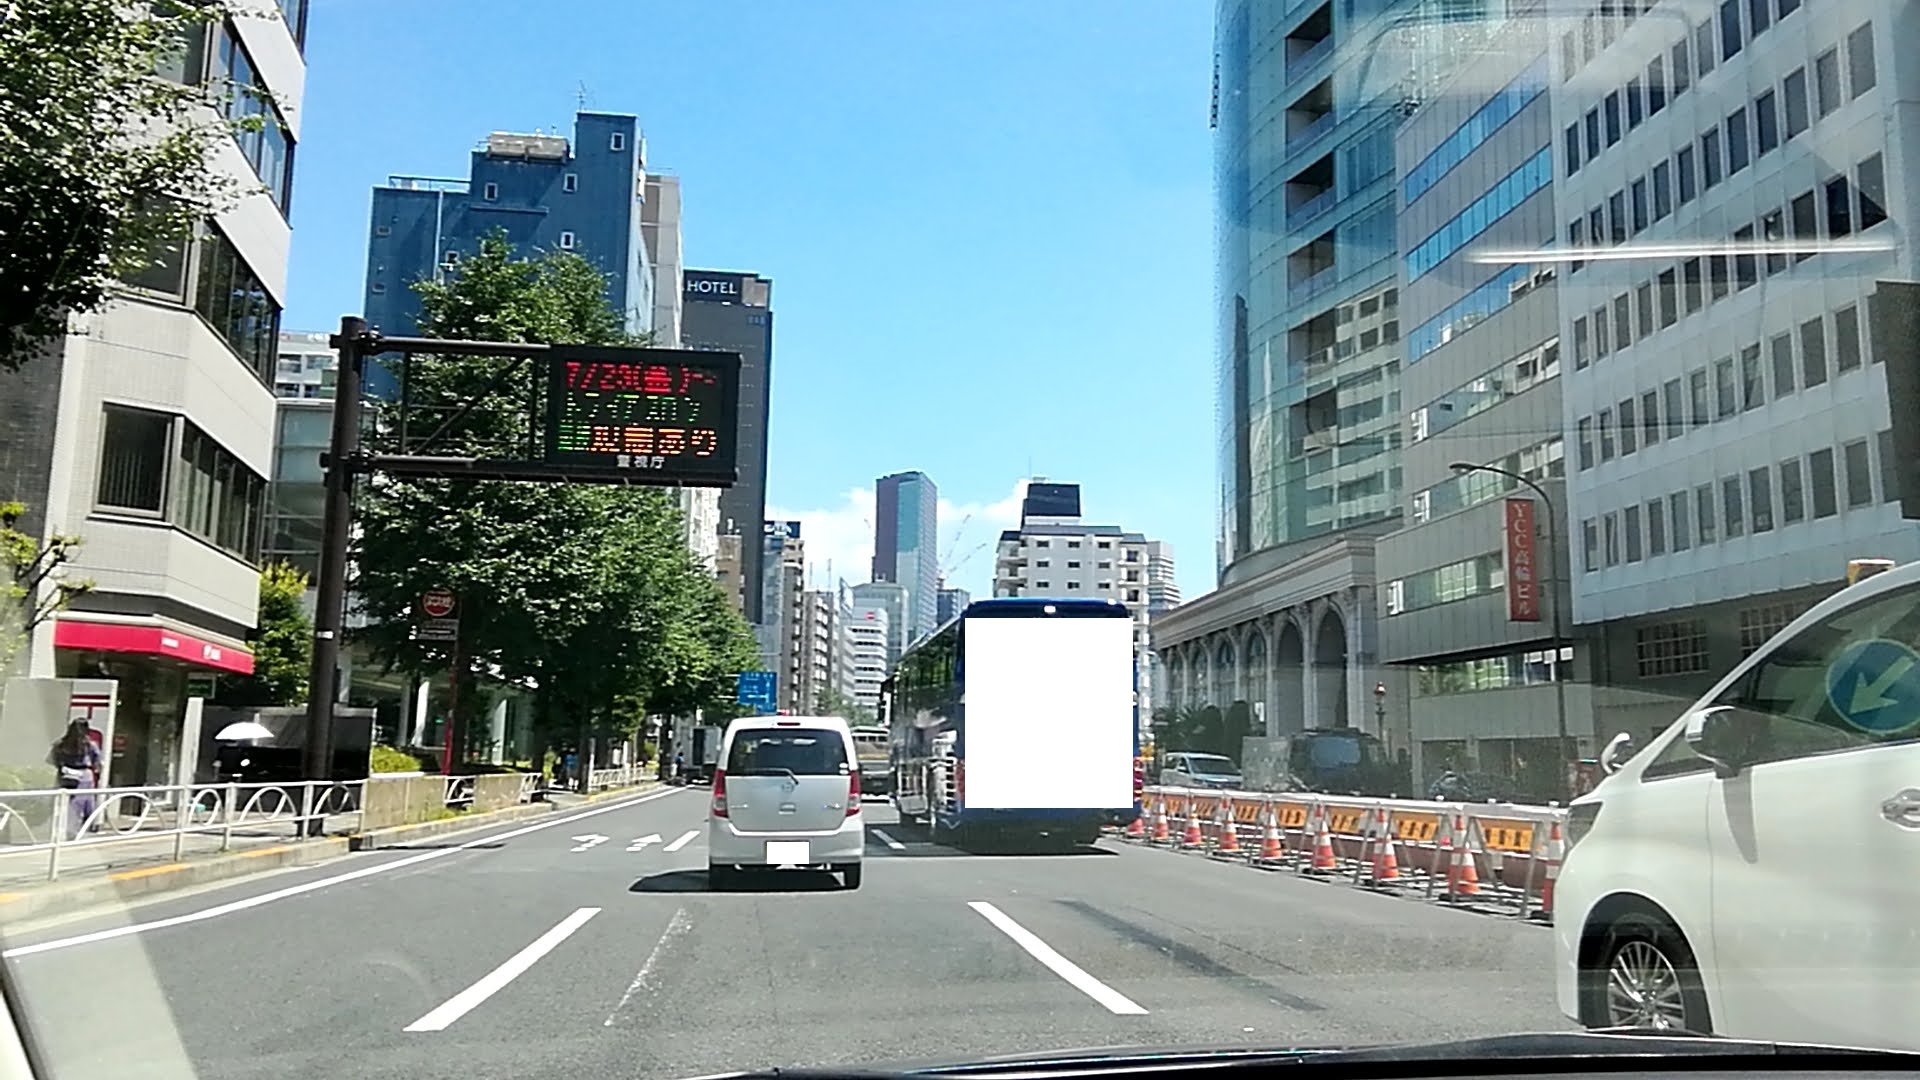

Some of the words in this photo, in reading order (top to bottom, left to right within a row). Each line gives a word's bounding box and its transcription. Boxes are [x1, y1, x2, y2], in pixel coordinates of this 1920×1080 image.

[687, 280, 738, 294] HOTEL
[616, 454, 665, 469] 警視庁
[1513, 503, 1532, 616] YCC高輪ビル
